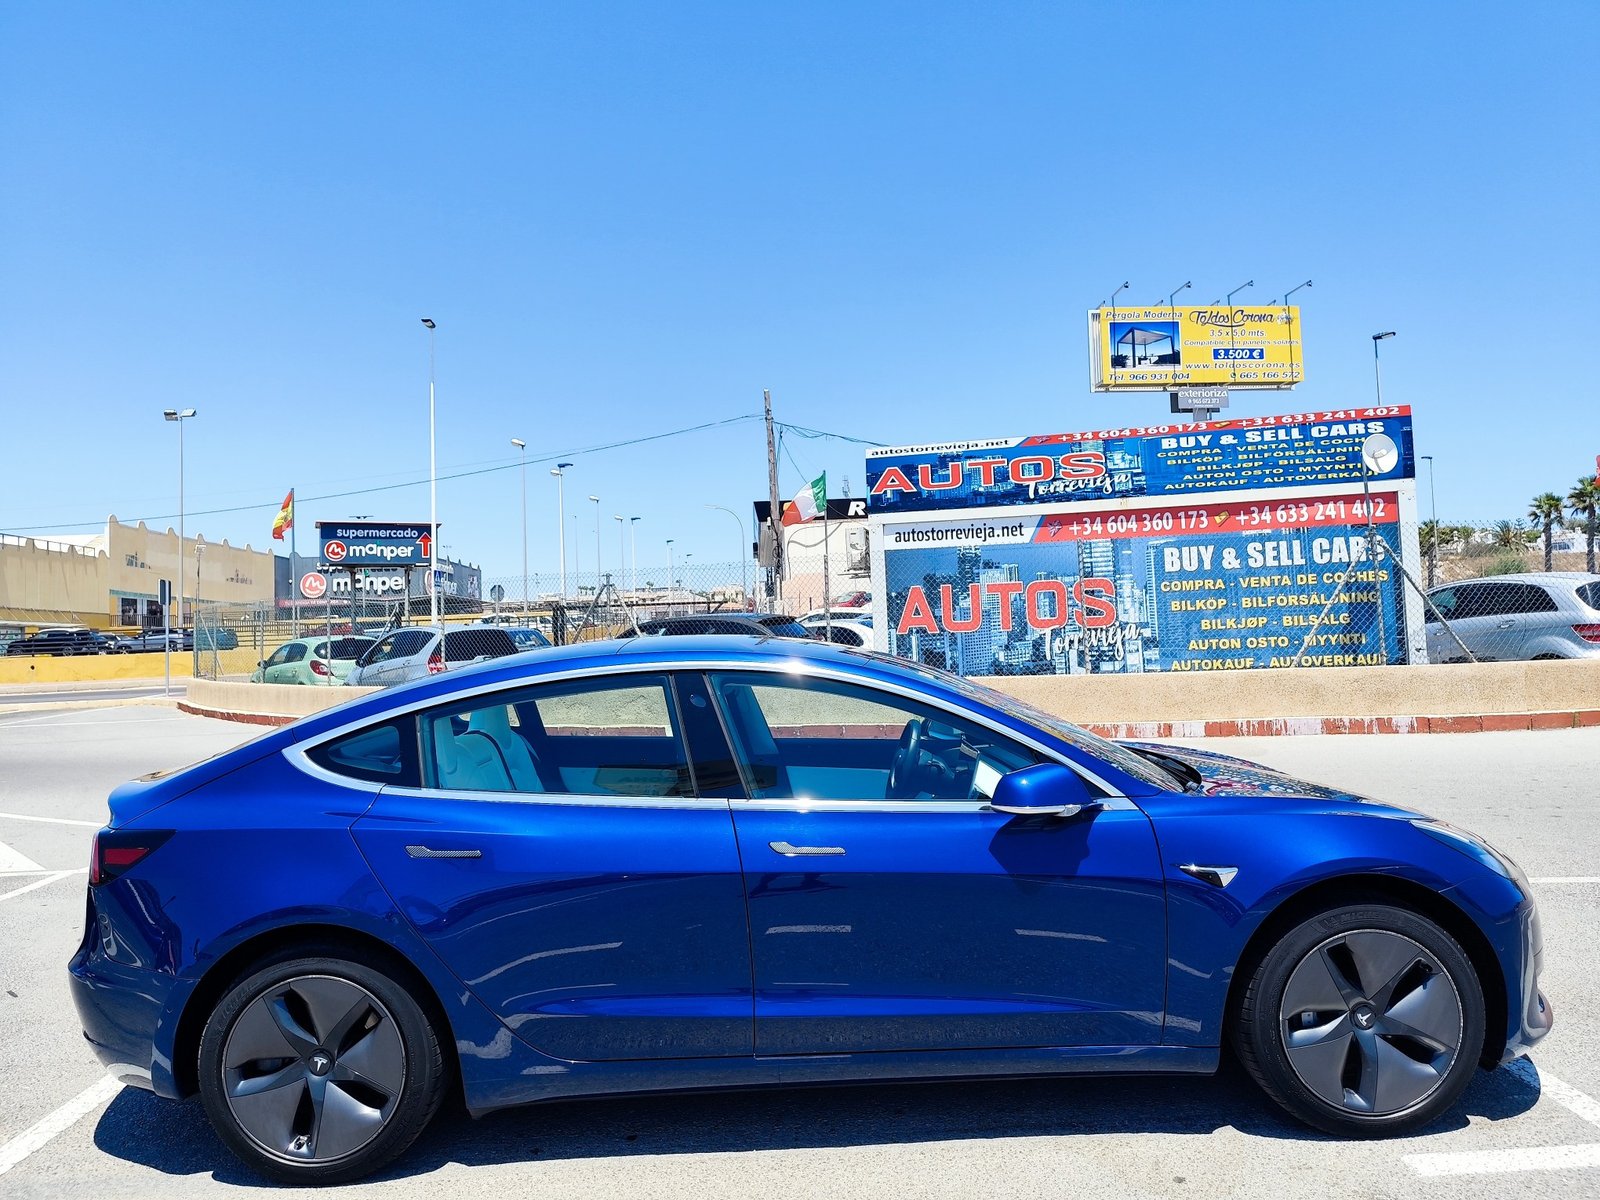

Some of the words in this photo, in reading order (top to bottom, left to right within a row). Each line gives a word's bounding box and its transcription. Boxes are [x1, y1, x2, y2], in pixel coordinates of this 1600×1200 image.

[1106, 311, 1140, 320] Pergola
[1189, 310, 1230, 326] Toldos
[1232, 309, 1274, 324] Corona
[1217, 349, 1250, 359] 3.500
[1253, 349, 1261, 358] €
[1185, 361, 1300, 369] www.toldoscorona.es
[1129, 373, 1148, 381] 966
[1178, 389, 1228, 398] exterioriza
[1237, 416, 1276, 427] +34
[1281, 413, 1316, 423] 633
[1322, 410, 1357, 420] 241
[1363, 406, 1400, 417] 402
[1058, 433, 1094, 443] +34
[1099, 429, 1132, 439] 604
[1137, 426, 1169, 435] 360
[1175, 422, 1208, 432] 173
[1161, 434, 1213, 450] BUY
[1219, 434, 1238, 445] &
[1245, 427, 1304, 443] SELL
[1311, 421, 1385, 438] CARS
[871, 439, 1010, 456] autostorrevieja.net
[1157, 447, 1222, 458] COMPRA
[1236, 442, 1288, 452] VENTA
[1294, 440, 1315, 448] DE
[1320, 436, 1367, 446] COCH
[1167, 454, 1223, 466] BILKÖP
[1238, 446, 1363, 460] BILFÖRSÄLJNIN
[1279, 456, 1347, 466] BILSALG
[871, 451, 1106, 494] AUTOS
[1183, 471, 1236, 480] AUTON
[1241, 467, 1284, 476] OSTO
[1299, 463, 1362, 472] MYYNTI
[1024, 472, 1132, 499] Torrevieja
[1164, 479, 1248, 490] AUTOKAUF
[1235, 505, 1272, 526] +34
[1276, 503, 1309, 523] 633
[1314, 500, 1346, 521] 241
[1068, 516, 1103, 536] +34
[1107, 514, 1138, 534] 604
[1142, 512, 1173, 532] 360
[1178, 509, 1208, 529] 173
[336, 527, 418, 539] supermercado
[894, 522, 1025, 543] autostorrevieja.net
[349, 543, 414, 560] manper
[1163, 545, 1215, 573] BUY
[1222, 547, 1241, 570] &
[1247, 540, 1306, 568] SELL
[1160, 579, 1225, 592] COMPRA
[1239, 575, 1291, 588] VENTA
[1297, 573, 1318, 585] DE
[1322, 570, 1389, 584] COCHES
[897, 577, 1117, 635] AUTOS
[1171, 597, 1227, 611] BILKÖP
[1201, 617, 1267, 630] BILKJØP
[1283, 613, 1351, 627] BILSALG
[1041, 622, 1142, 661] Torrevieja
[1188, 638, 1241, 650] AUTON
[1246, 636, 1289, 649] OSTO
[1304, 633, 1366, 646] MYYNTI
[1171, 657, 1254, 671] AUTOKAUF
[1270, 653, 1384, 668] AUOVERKAU
